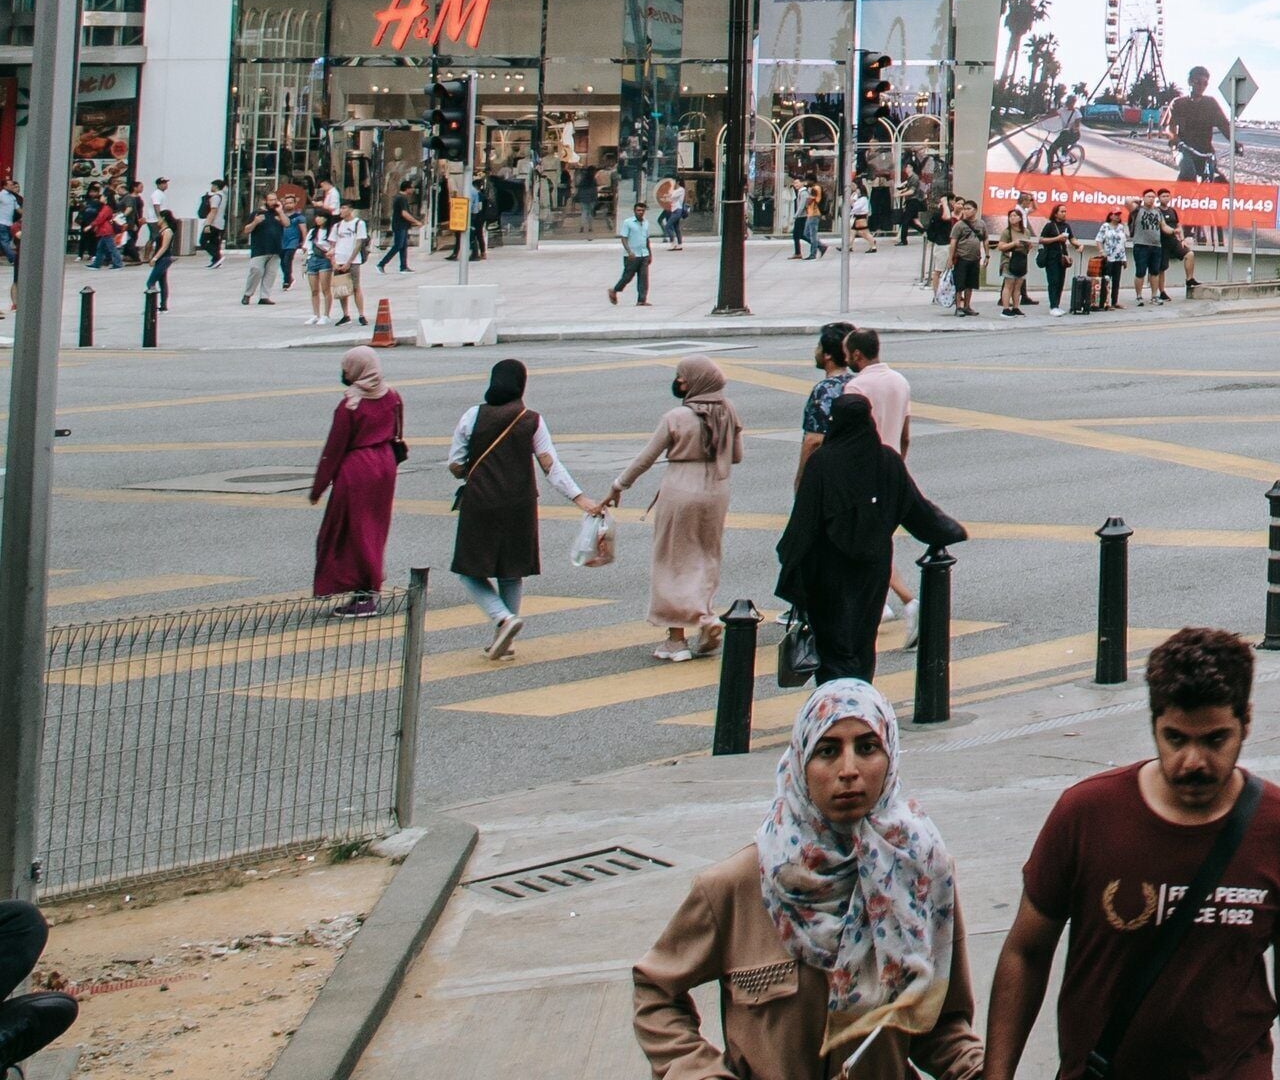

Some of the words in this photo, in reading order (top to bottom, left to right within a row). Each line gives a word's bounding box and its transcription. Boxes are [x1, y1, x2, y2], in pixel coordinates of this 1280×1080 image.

[989, 186, 1048, 203] Terbng
[1051, 188, 1069, 202] ke
[1154, 195, 1218, 212] dripada
[1221, 197, 1274, 212] RM449
[1214, 886, 1269, 904] PERRY
[1218, 909, 1255, 925] 1952
